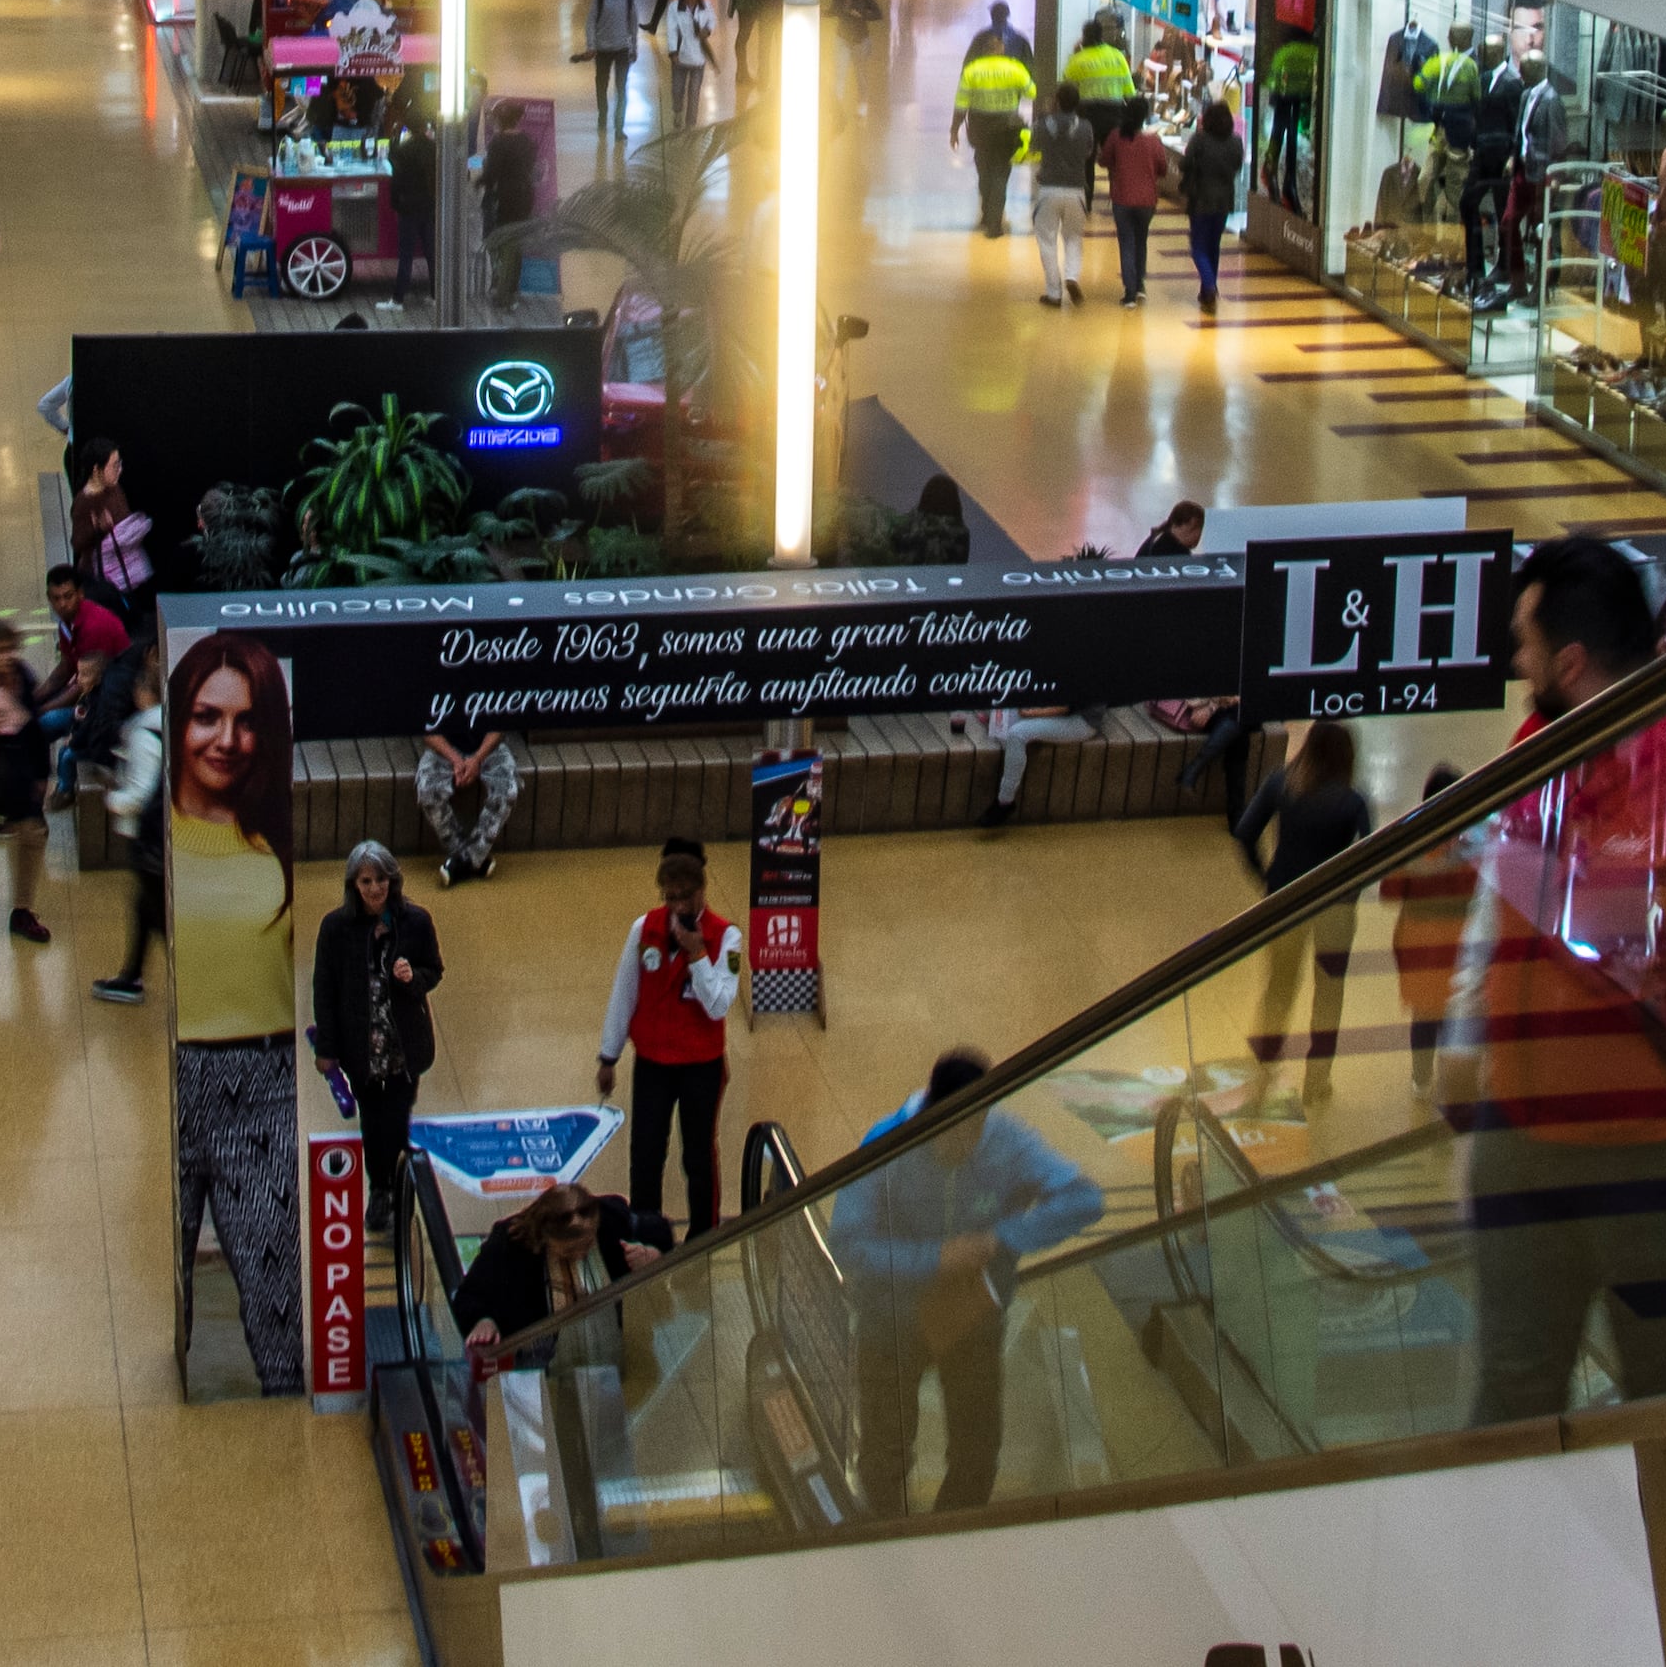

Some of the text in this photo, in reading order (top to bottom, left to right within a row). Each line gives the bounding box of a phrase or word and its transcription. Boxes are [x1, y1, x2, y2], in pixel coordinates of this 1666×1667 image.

[469, 428, 561, 447] mazda
[220, 558, 1238, 619] Femenino Tallas Grandes Masculino
[440, 609, 1031, 671] Desde 1963, somos una gran historia
[425, 690, 454, 732] y
[464, 683, 610, 729] queremos
[620, 669, 751, 722] seguirla
[759, 665, 918, 716] ampliando
[1309, 683, 1439, 717] Loc 1-94
[322, 1189, 353, 1385] NO PASE
